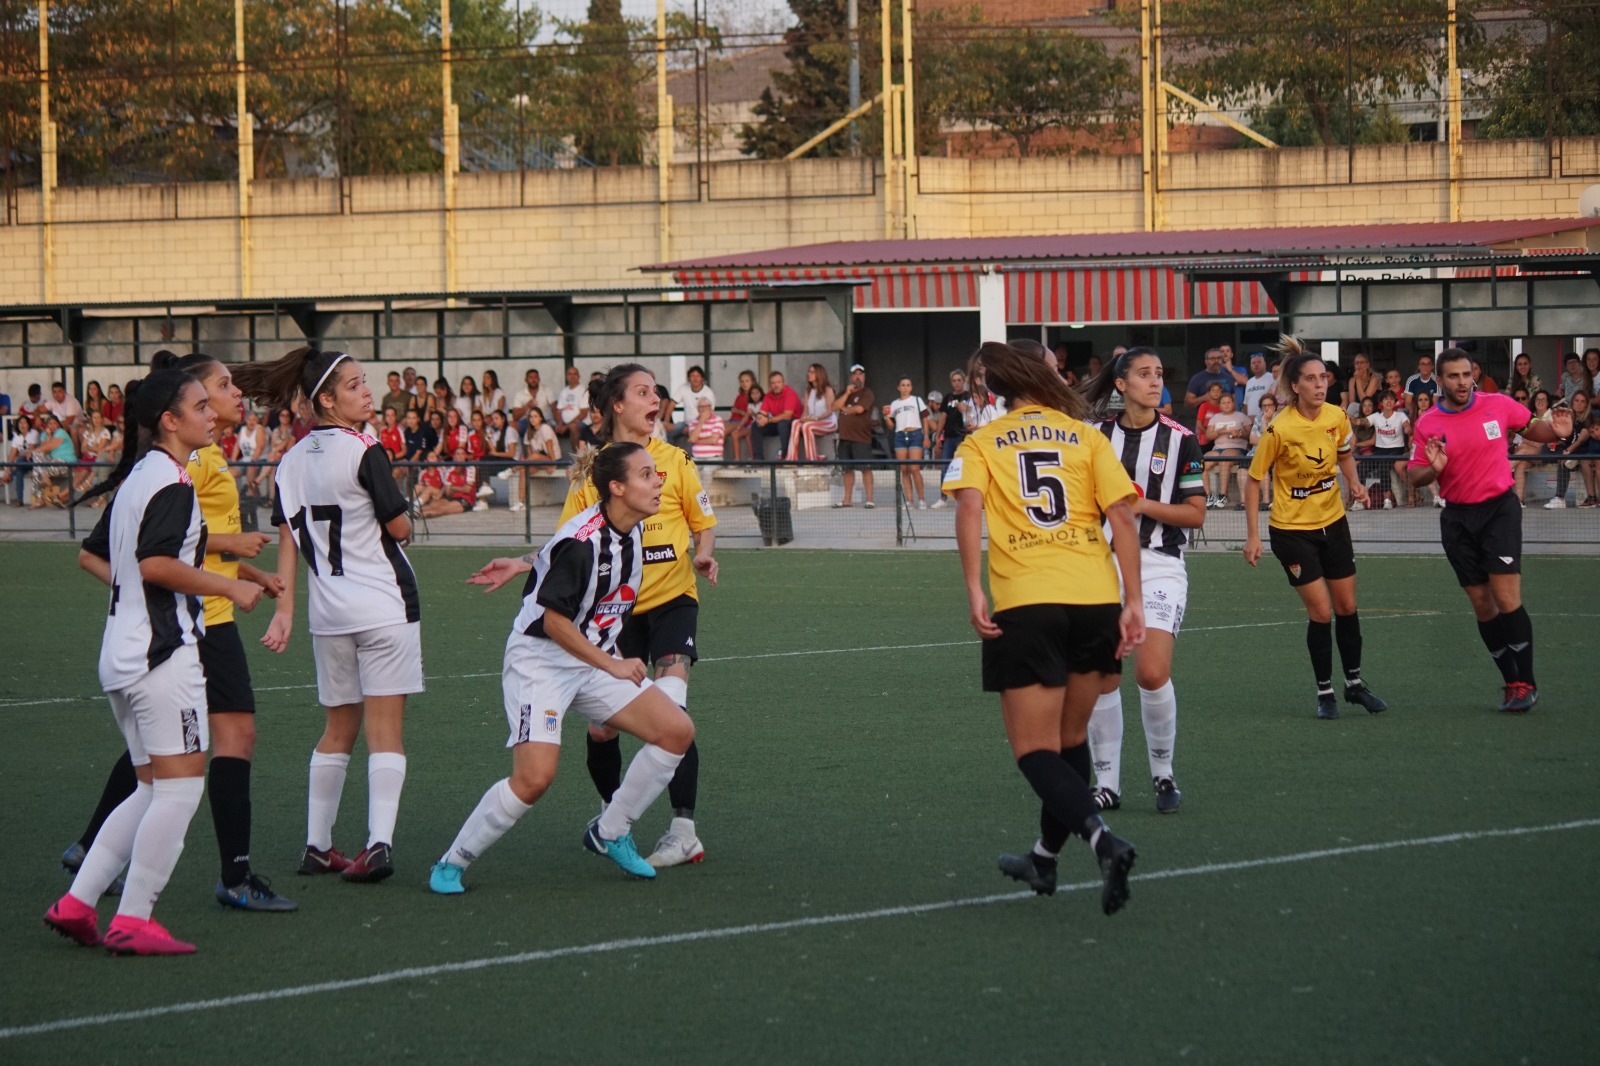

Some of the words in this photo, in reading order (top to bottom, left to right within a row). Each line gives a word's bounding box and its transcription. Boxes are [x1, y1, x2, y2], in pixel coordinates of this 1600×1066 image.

[996, 425, 1079, 449] ARIADNA
[1017, 450, 1068, 529] 5
[289, 504, 344, 577] 17
[597, 603, 632, 614] DERBY
